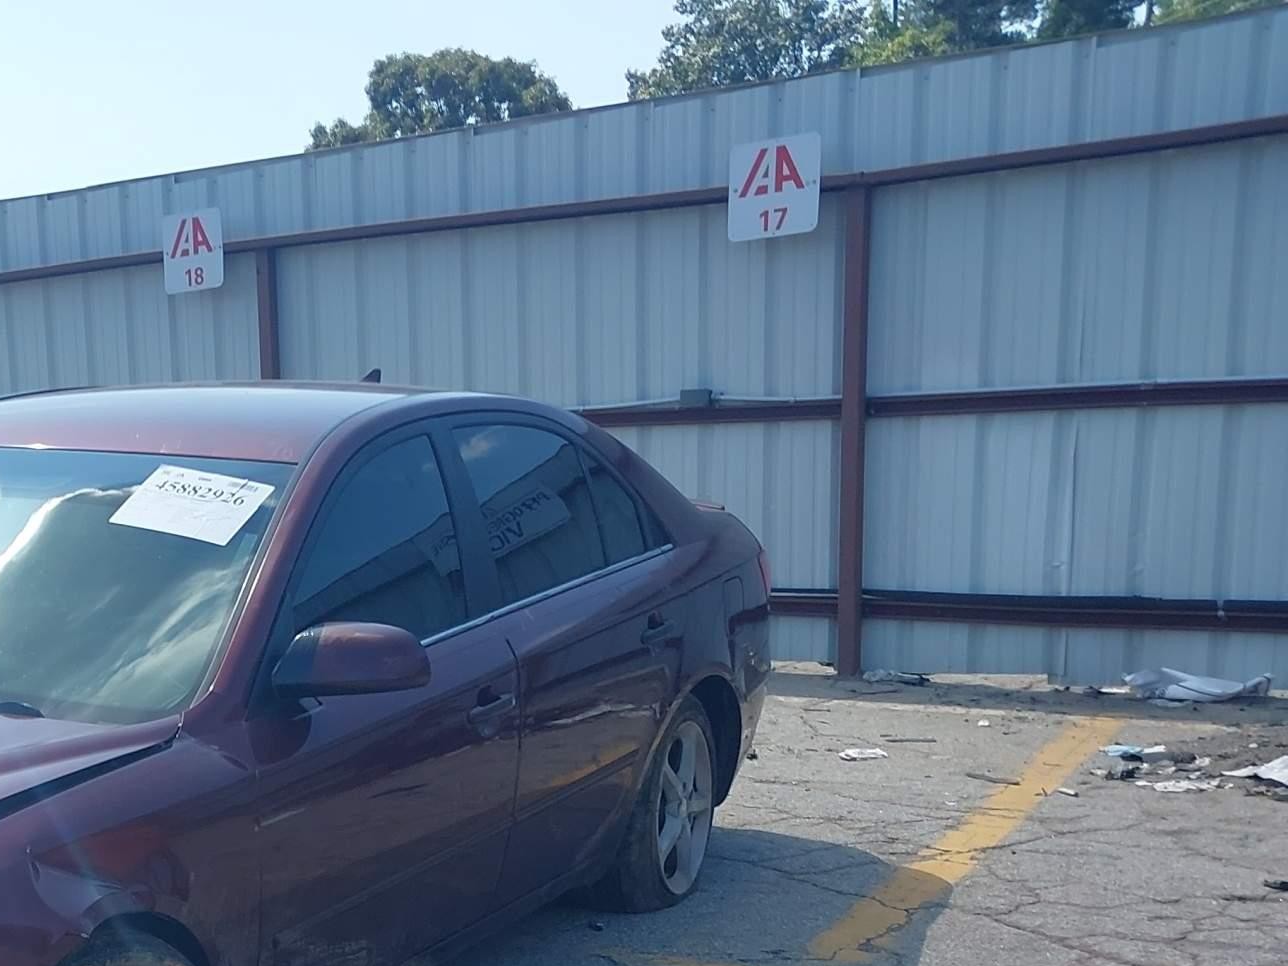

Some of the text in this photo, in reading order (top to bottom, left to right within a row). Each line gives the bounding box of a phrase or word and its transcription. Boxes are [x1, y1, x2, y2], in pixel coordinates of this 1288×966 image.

[759, 207, 788, 232] 17
[184, 266, 204, 287] 18
[155, 479, 245, 506] 45882926
